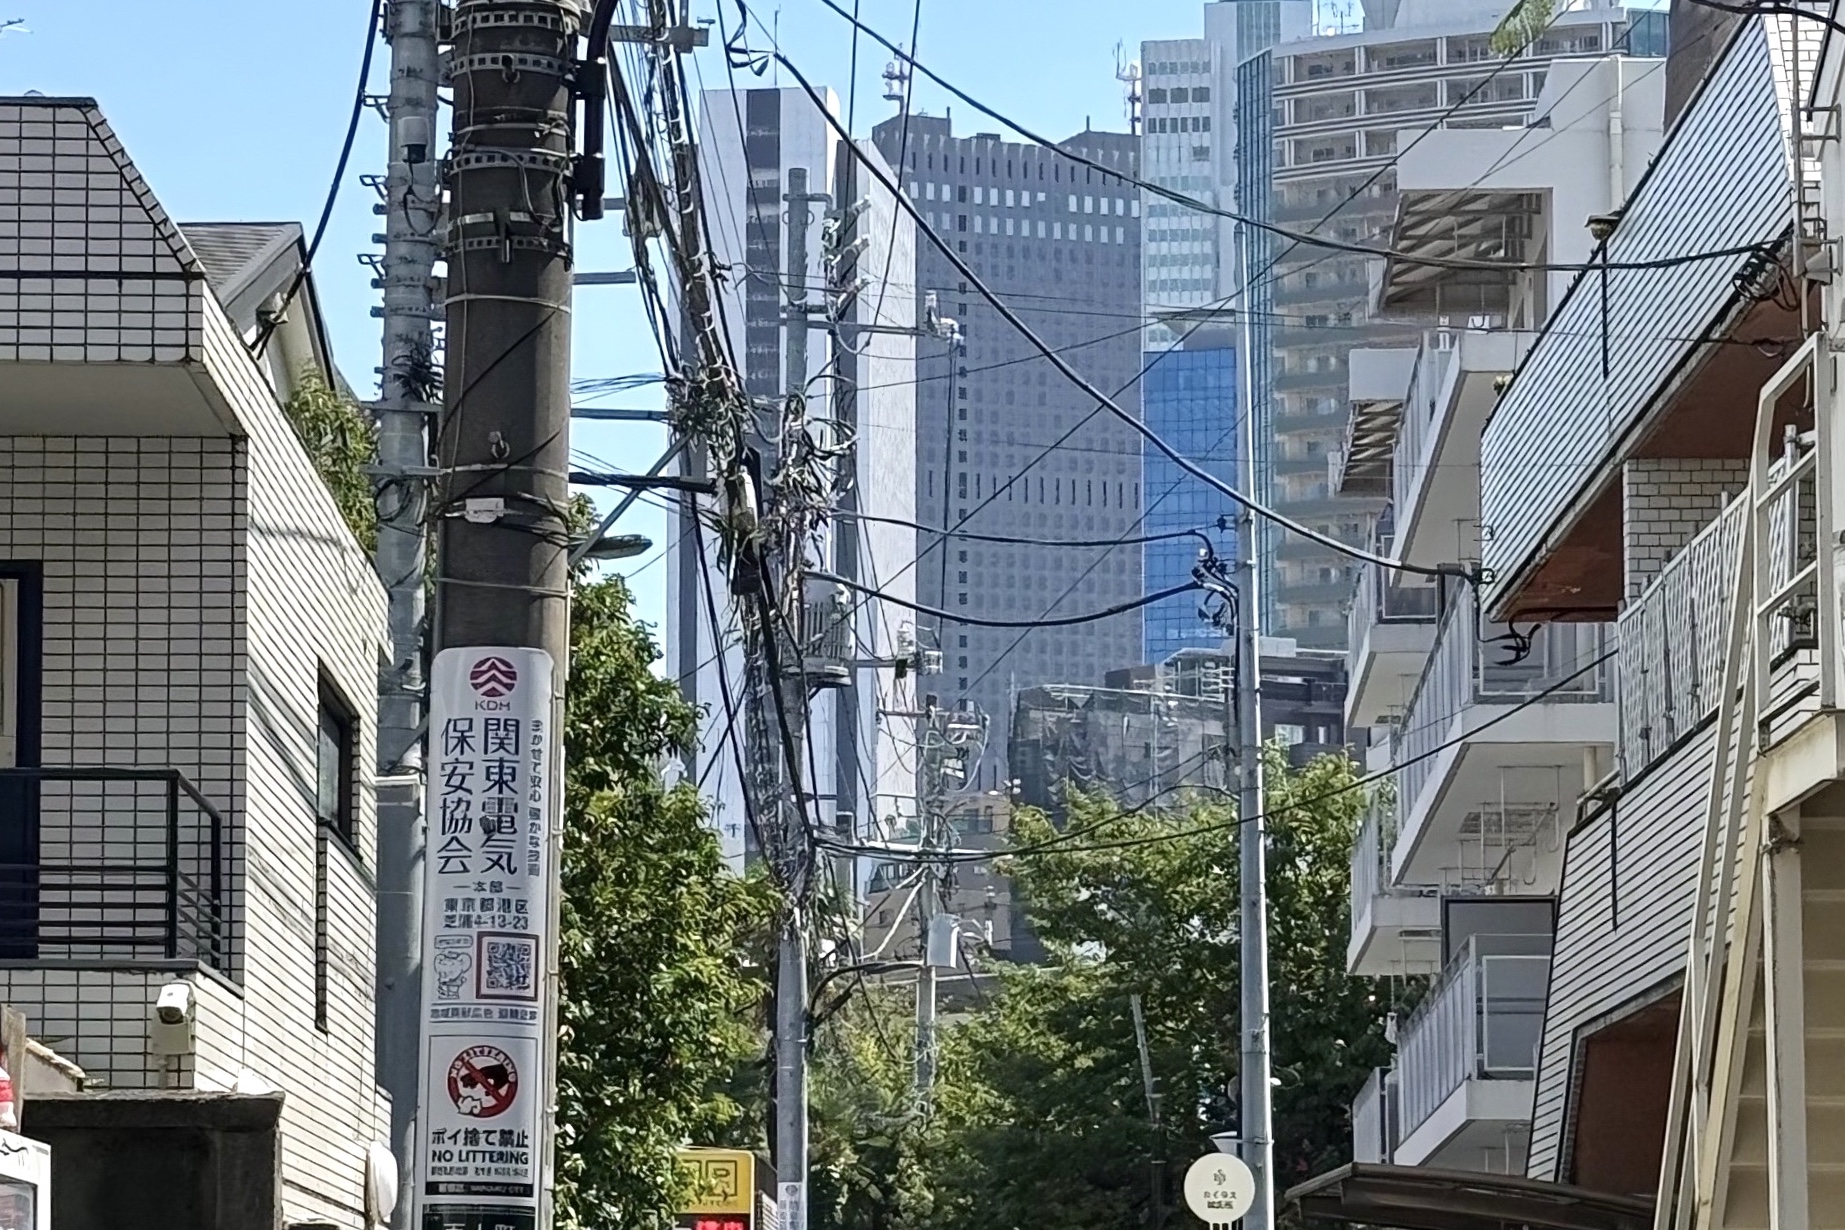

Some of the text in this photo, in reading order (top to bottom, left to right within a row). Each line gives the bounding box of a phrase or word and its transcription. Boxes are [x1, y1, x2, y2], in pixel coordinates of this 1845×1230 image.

[474, 699, 511, 712] KDH
[437, 717, 476, 875] 保安協会
[480, 717, 520, 875] 関東電気
[431, 1127, 529, 1148] ポイ捨て禁止
[432, 1149, 529, 1165] NO LITTERING
